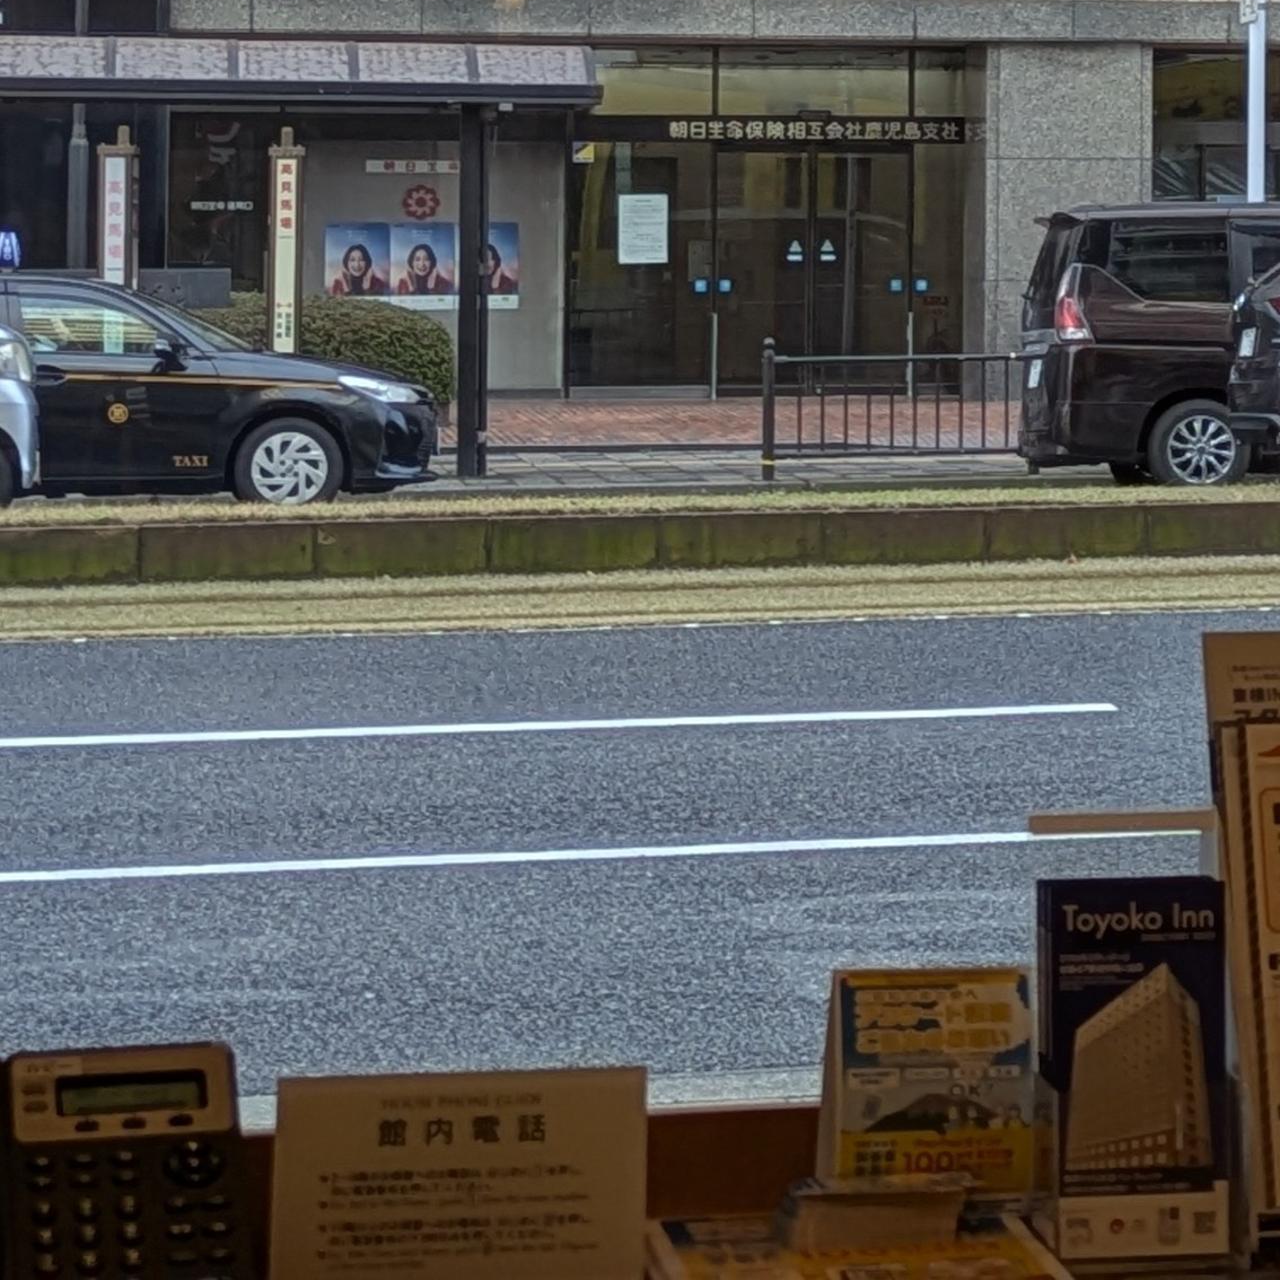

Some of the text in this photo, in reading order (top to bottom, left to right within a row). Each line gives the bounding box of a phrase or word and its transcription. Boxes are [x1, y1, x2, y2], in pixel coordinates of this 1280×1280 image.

[172, 455, 209, 468] TAXI
[1061, 900, 1216, 940] Toyoko Inn
[377, 1113, 547, 1148] 館内電話
